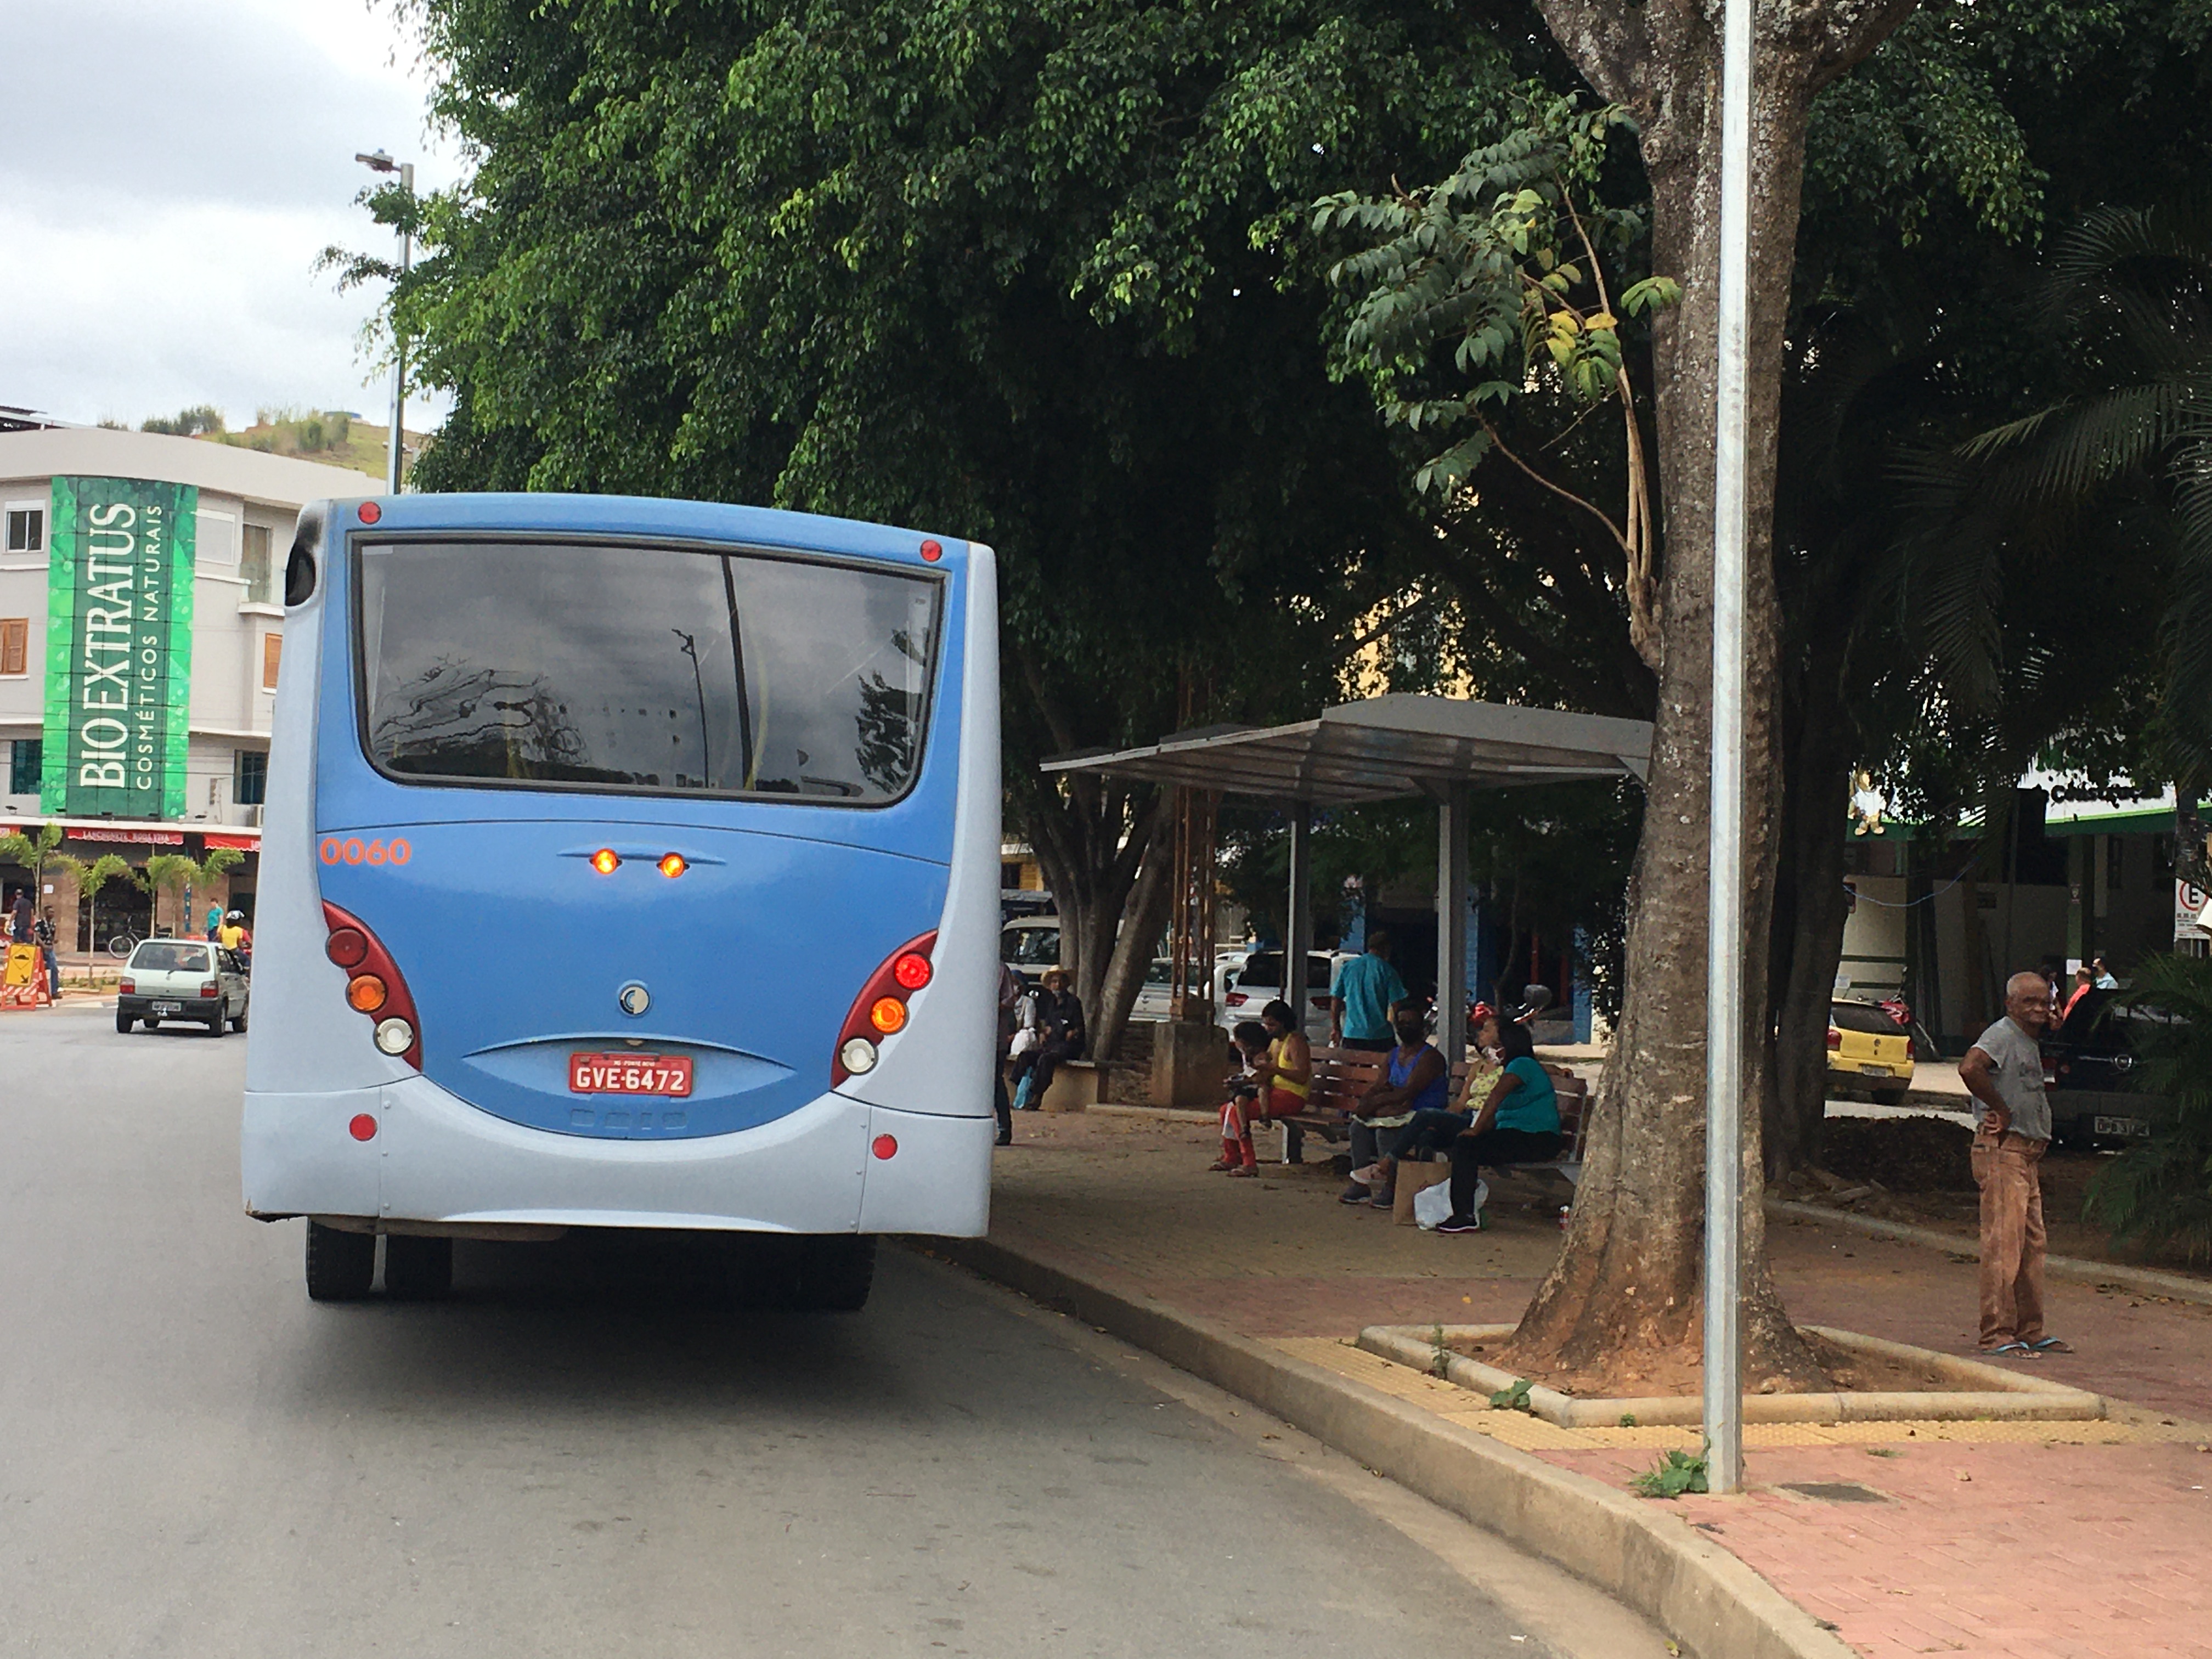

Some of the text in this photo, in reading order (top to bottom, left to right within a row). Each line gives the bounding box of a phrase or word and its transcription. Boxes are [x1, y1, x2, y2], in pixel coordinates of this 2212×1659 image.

[80, 503, 136, 788] BIO EXTRATUS
[135, 505, 163, 790] COSMÉTICOS NATURAIS
[320, 837, 412, 866] 0060
[2189, 882, 2199, 904] E
